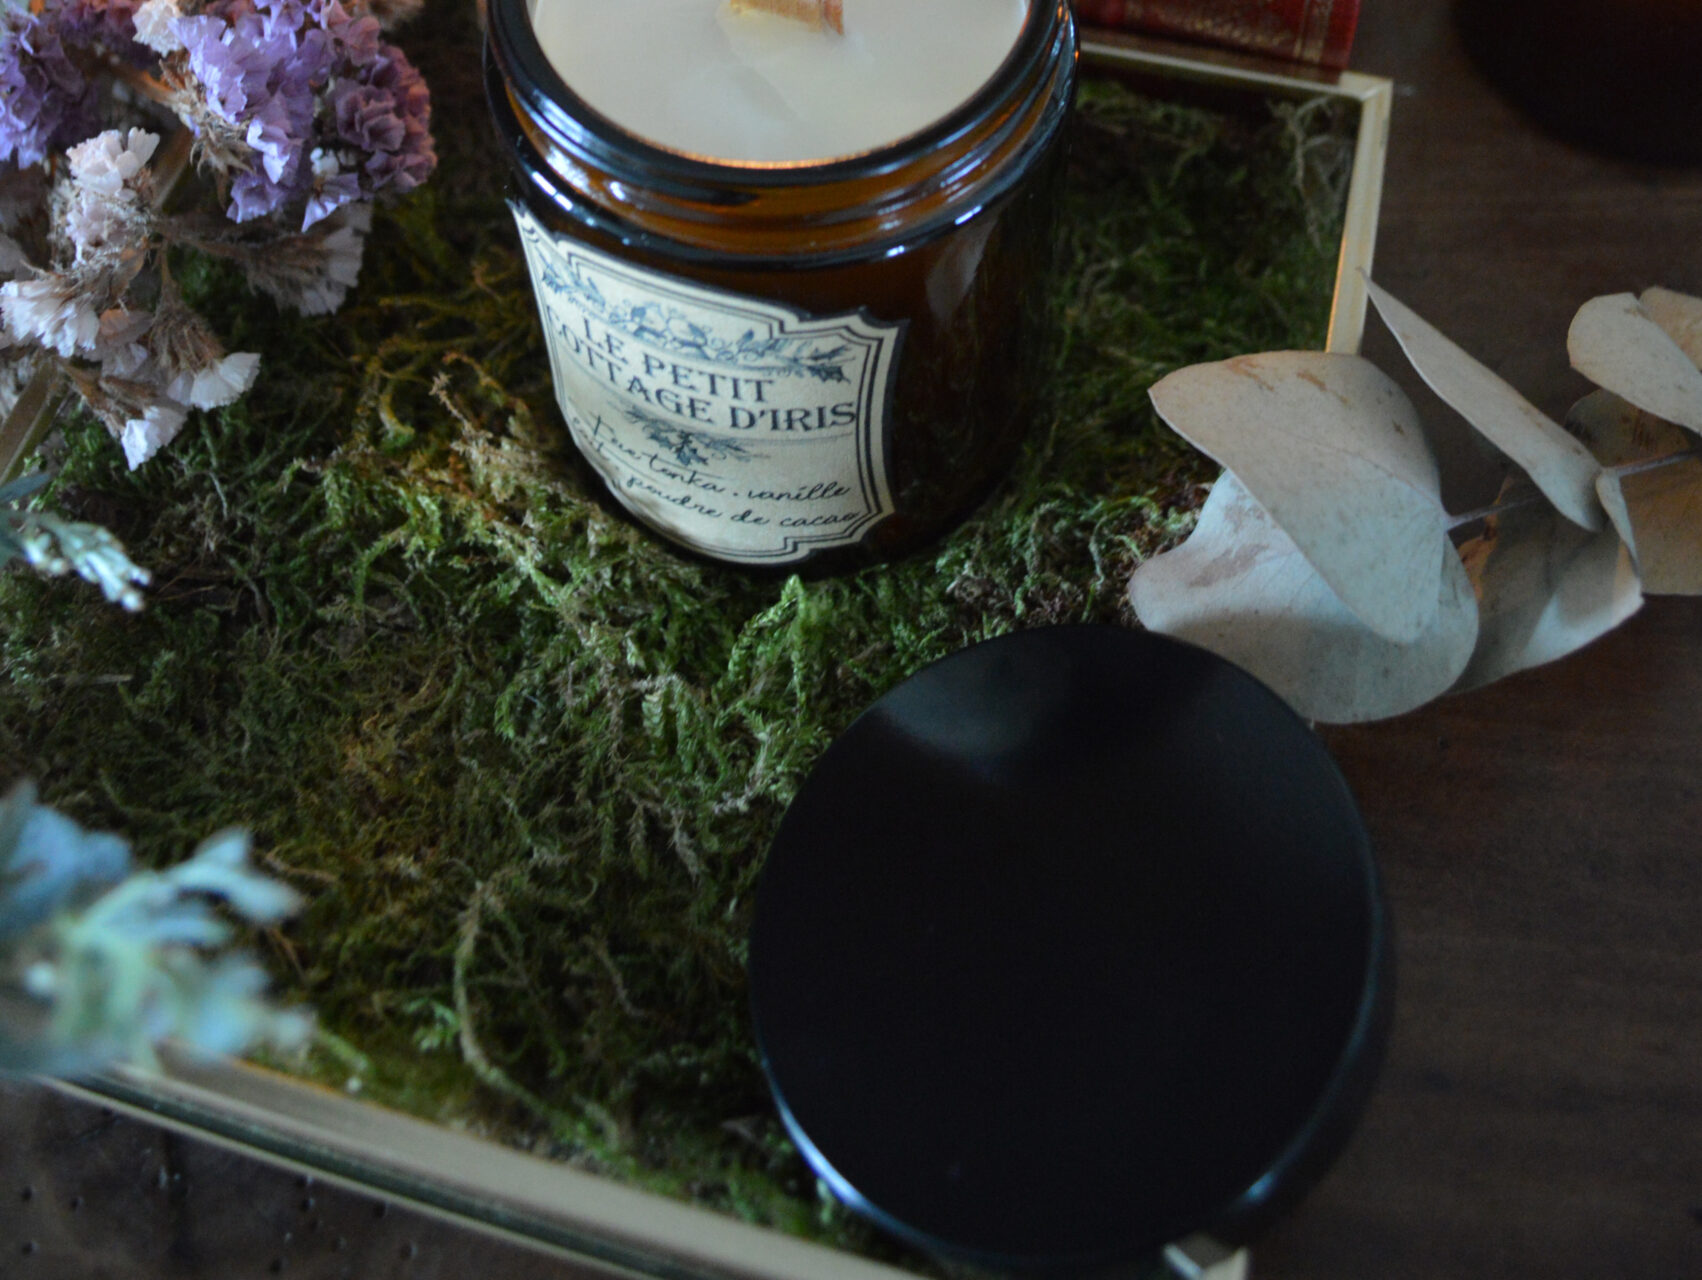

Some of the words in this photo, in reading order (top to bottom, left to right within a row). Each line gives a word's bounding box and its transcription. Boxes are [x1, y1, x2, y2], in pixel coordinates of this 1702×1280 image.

[546, 303, 716, 424] COTTAGE
[729, 401, 858, 432] D'IRIS
[582, 317, 630, 366] LE
[642, 351, 774, 403] PETIT
[730, 508, 771, 526] de
[778, 510, 862, 528] cacao
[747, 480, 852, 502] vanille
